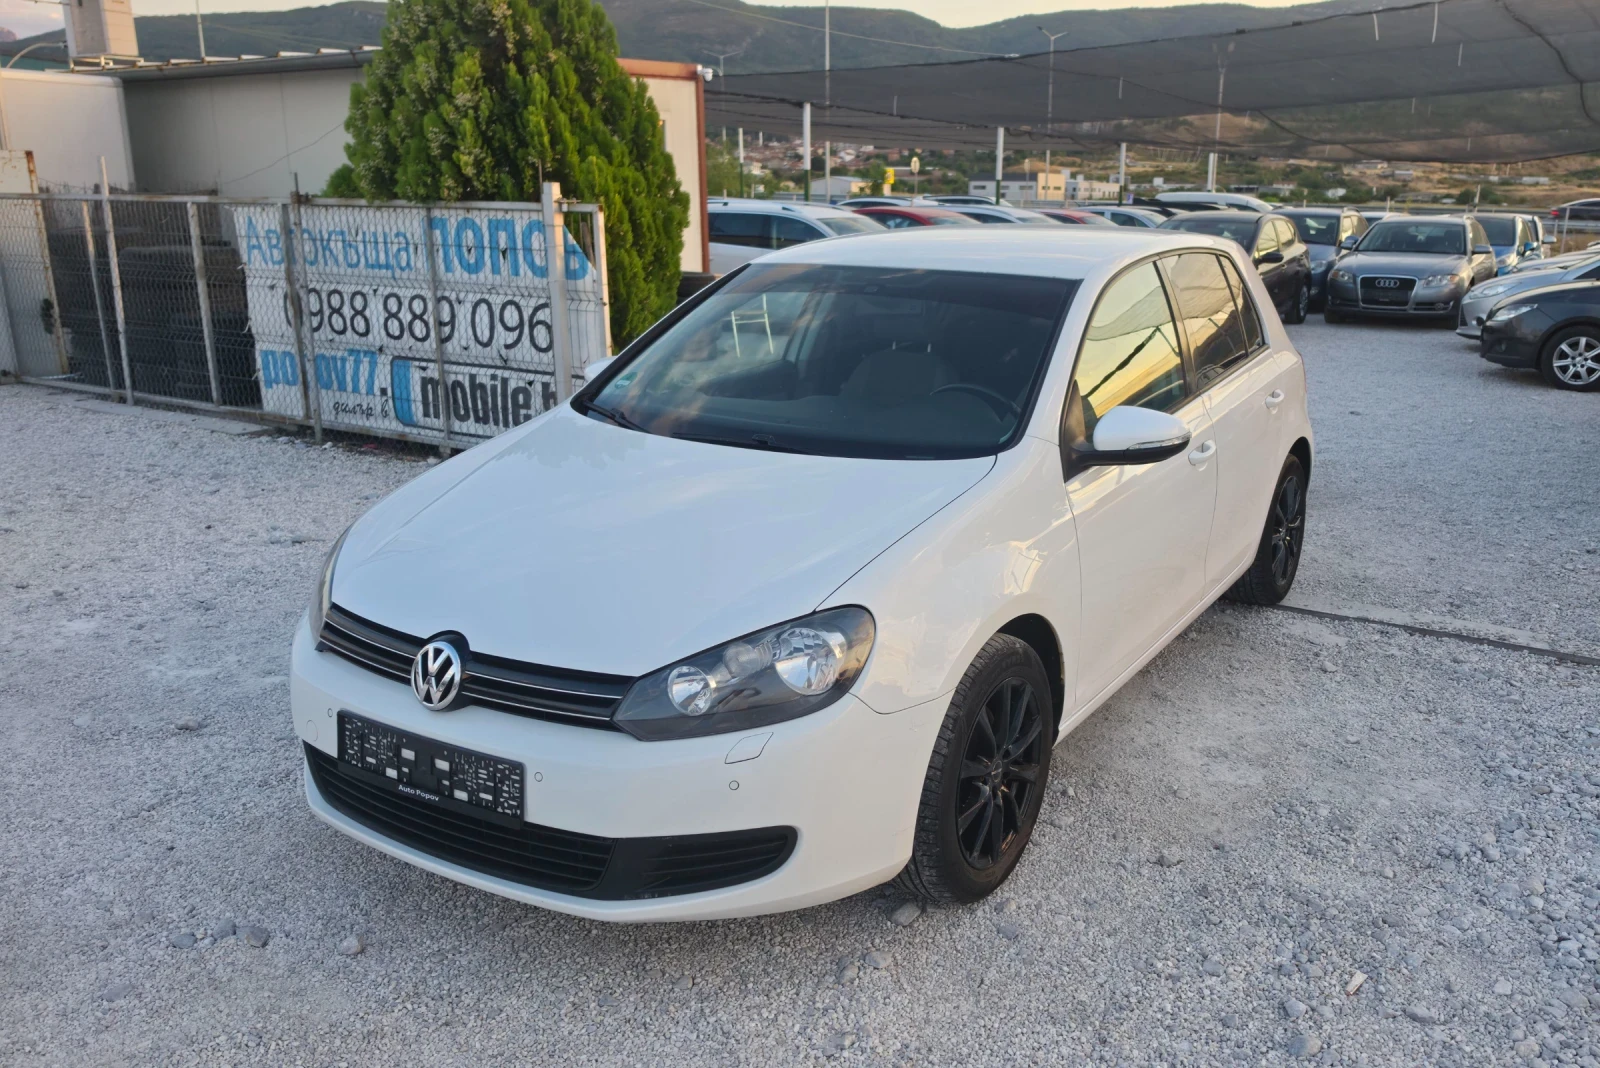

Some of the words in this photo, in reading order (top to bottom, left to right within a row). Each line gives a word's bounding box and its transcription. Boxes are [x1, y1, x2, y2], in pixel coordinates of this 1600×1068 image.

[382, 292, 456, 344] 889
[470, 297, 553, 353] 096
[398, 784, 416, 795] Auto
[416, 789, 440, 801] Popov
